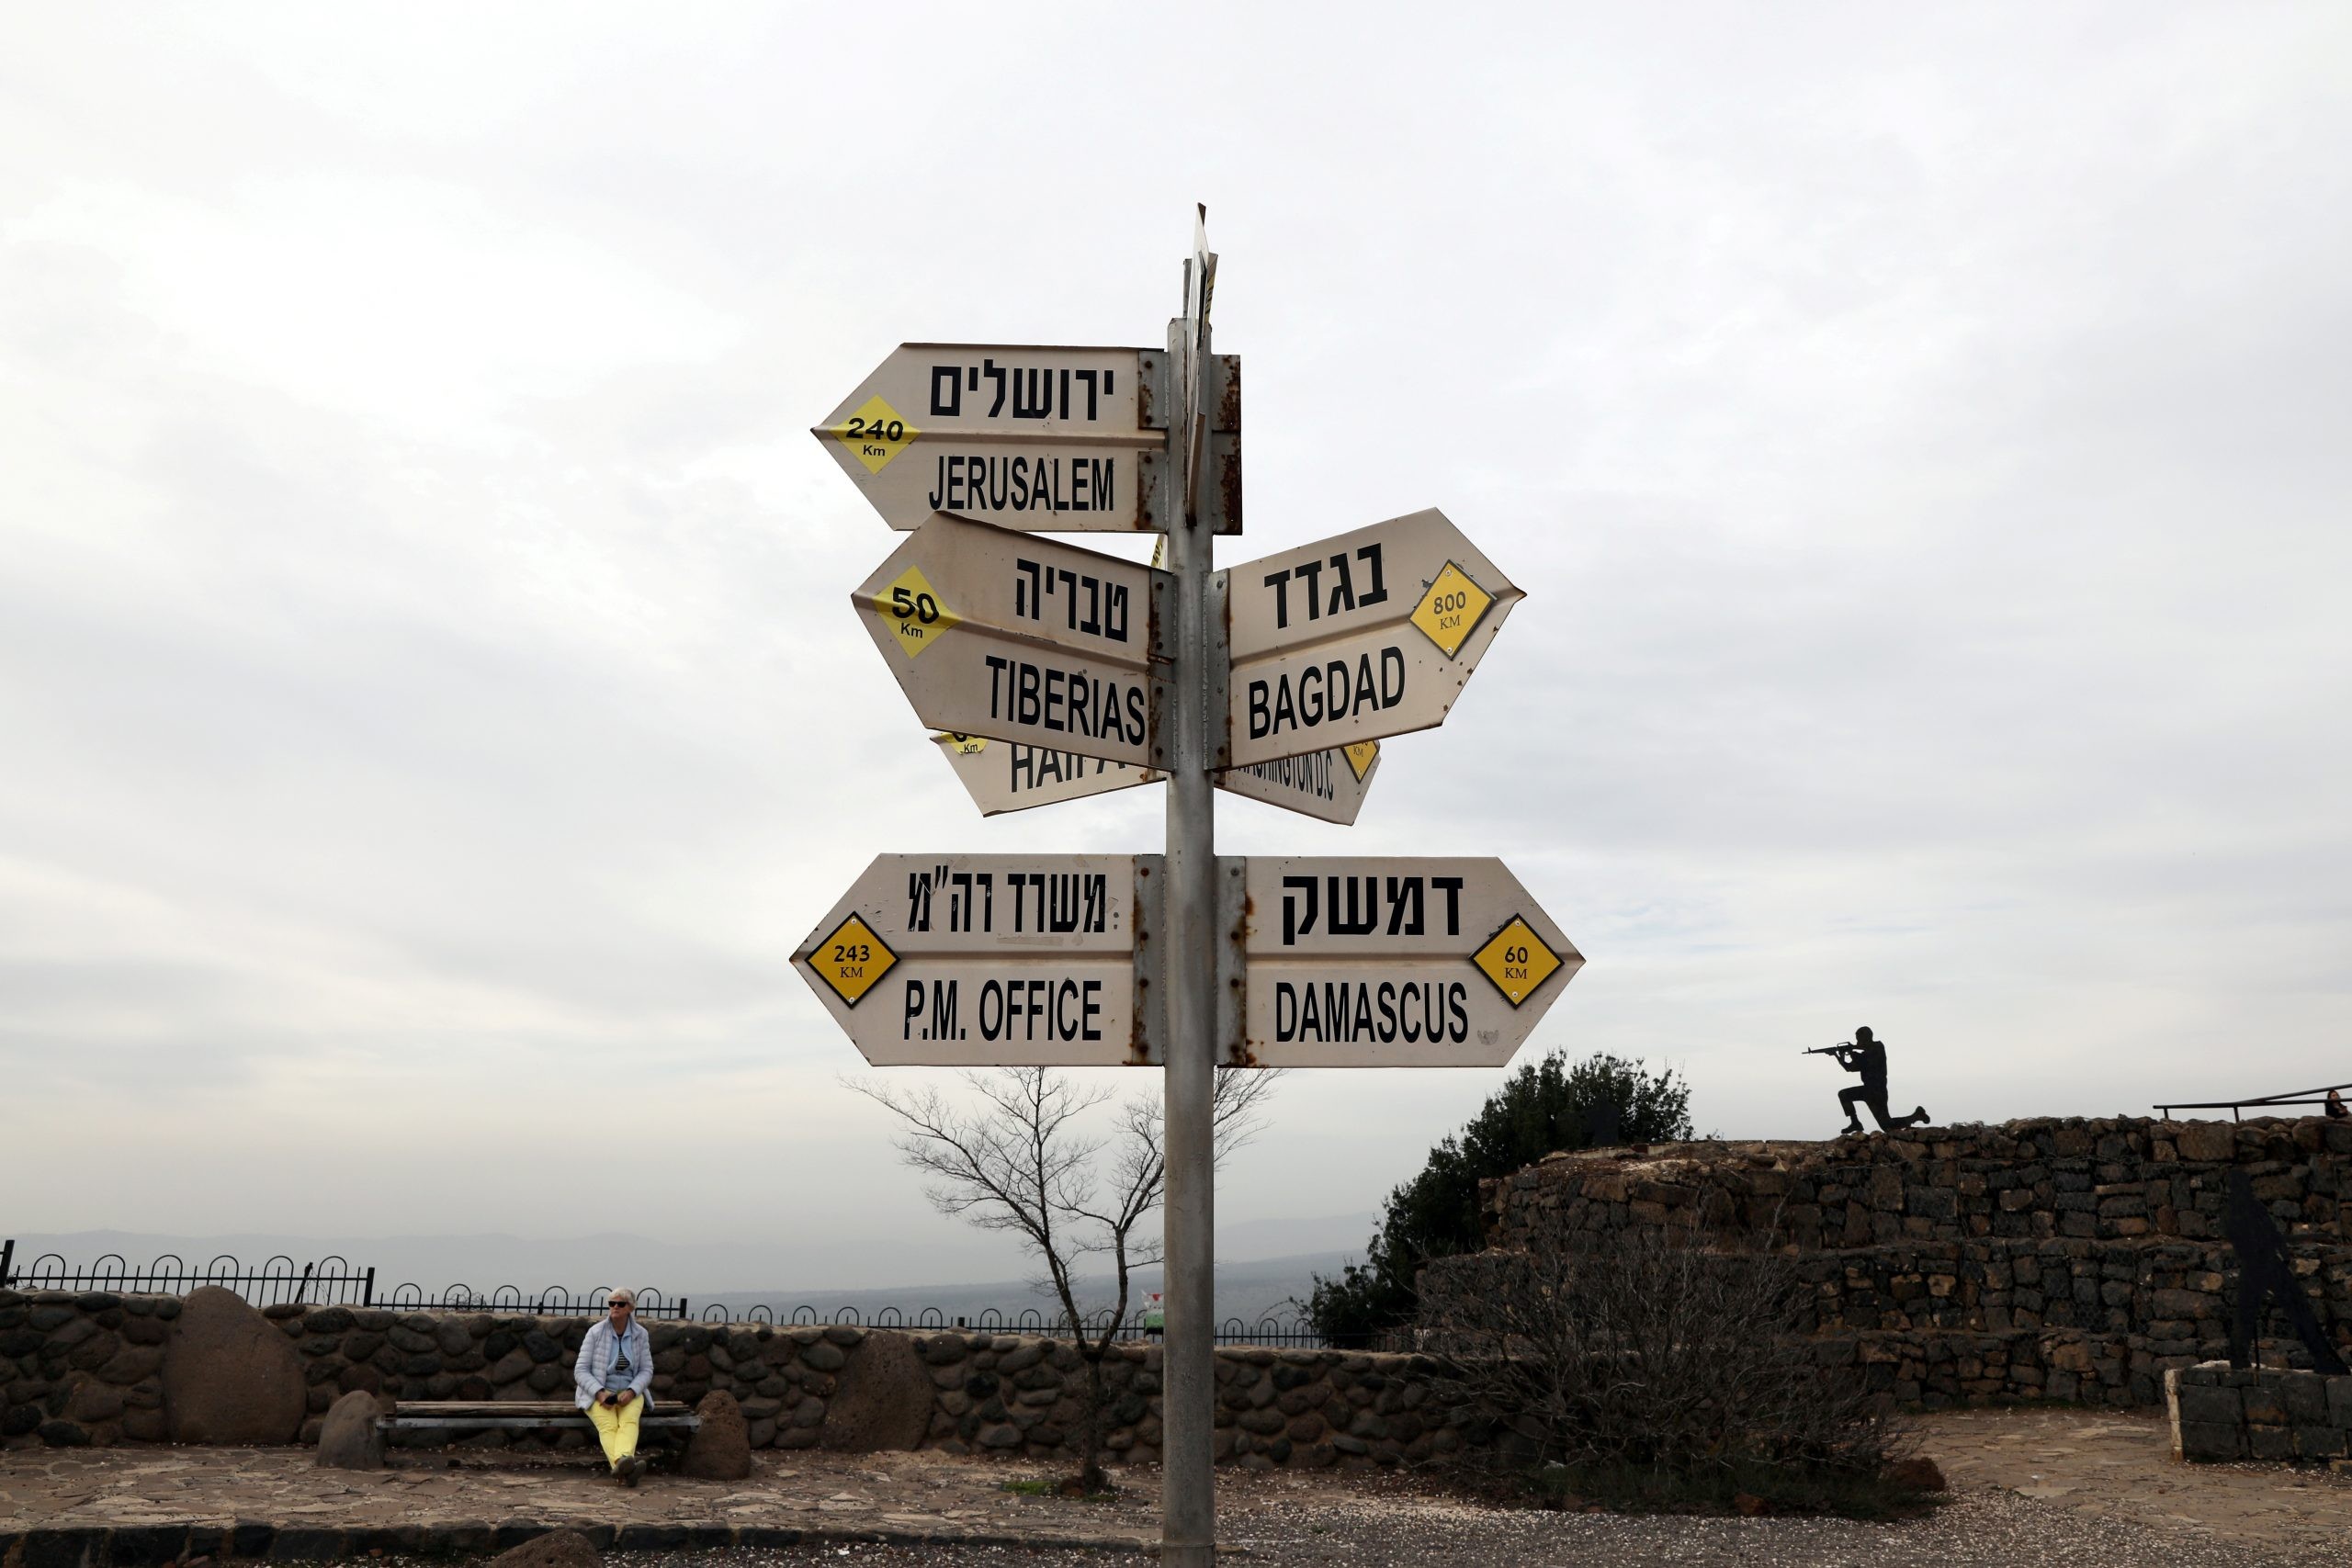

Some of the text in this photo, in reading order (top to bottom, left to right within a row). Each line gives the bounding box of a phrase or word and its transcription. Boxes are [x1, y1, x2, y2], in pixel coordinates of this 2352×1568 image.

[931, 359, 1114, 420] ירושלים
[846, 418, 903, 442] 240
[863, 445, 886, 457] Km
[929, 457, 1114, 512] JERUSALEM
[892, 587, 940, 625] 50
[1016, 558, 1128, 643] טבריה
[1264, 543, 1387, 629] בגדד
[1433, 591, 1466, 615] 800
[900, 622, 923, 638] Km
[1440, 614, 1461, 630] KM
[985, 655, 1146, 746] TIBERIAS
[1249, 646, 1406, 739] BAGDAD
[1007, 873, 1105, 932] משרד
[1283, 876, 1464, 945] דמשק
[834, 945, 871, 963] 243
[840, 966, 864, 978] KM
[1504, 946, 1529, 964] 60
[1505, 967, 1528, 980] KM
[903, 979, 1102, 1042] P.M. OFFICE
[1275, 982, 1468, 1043] DAMASCUS
